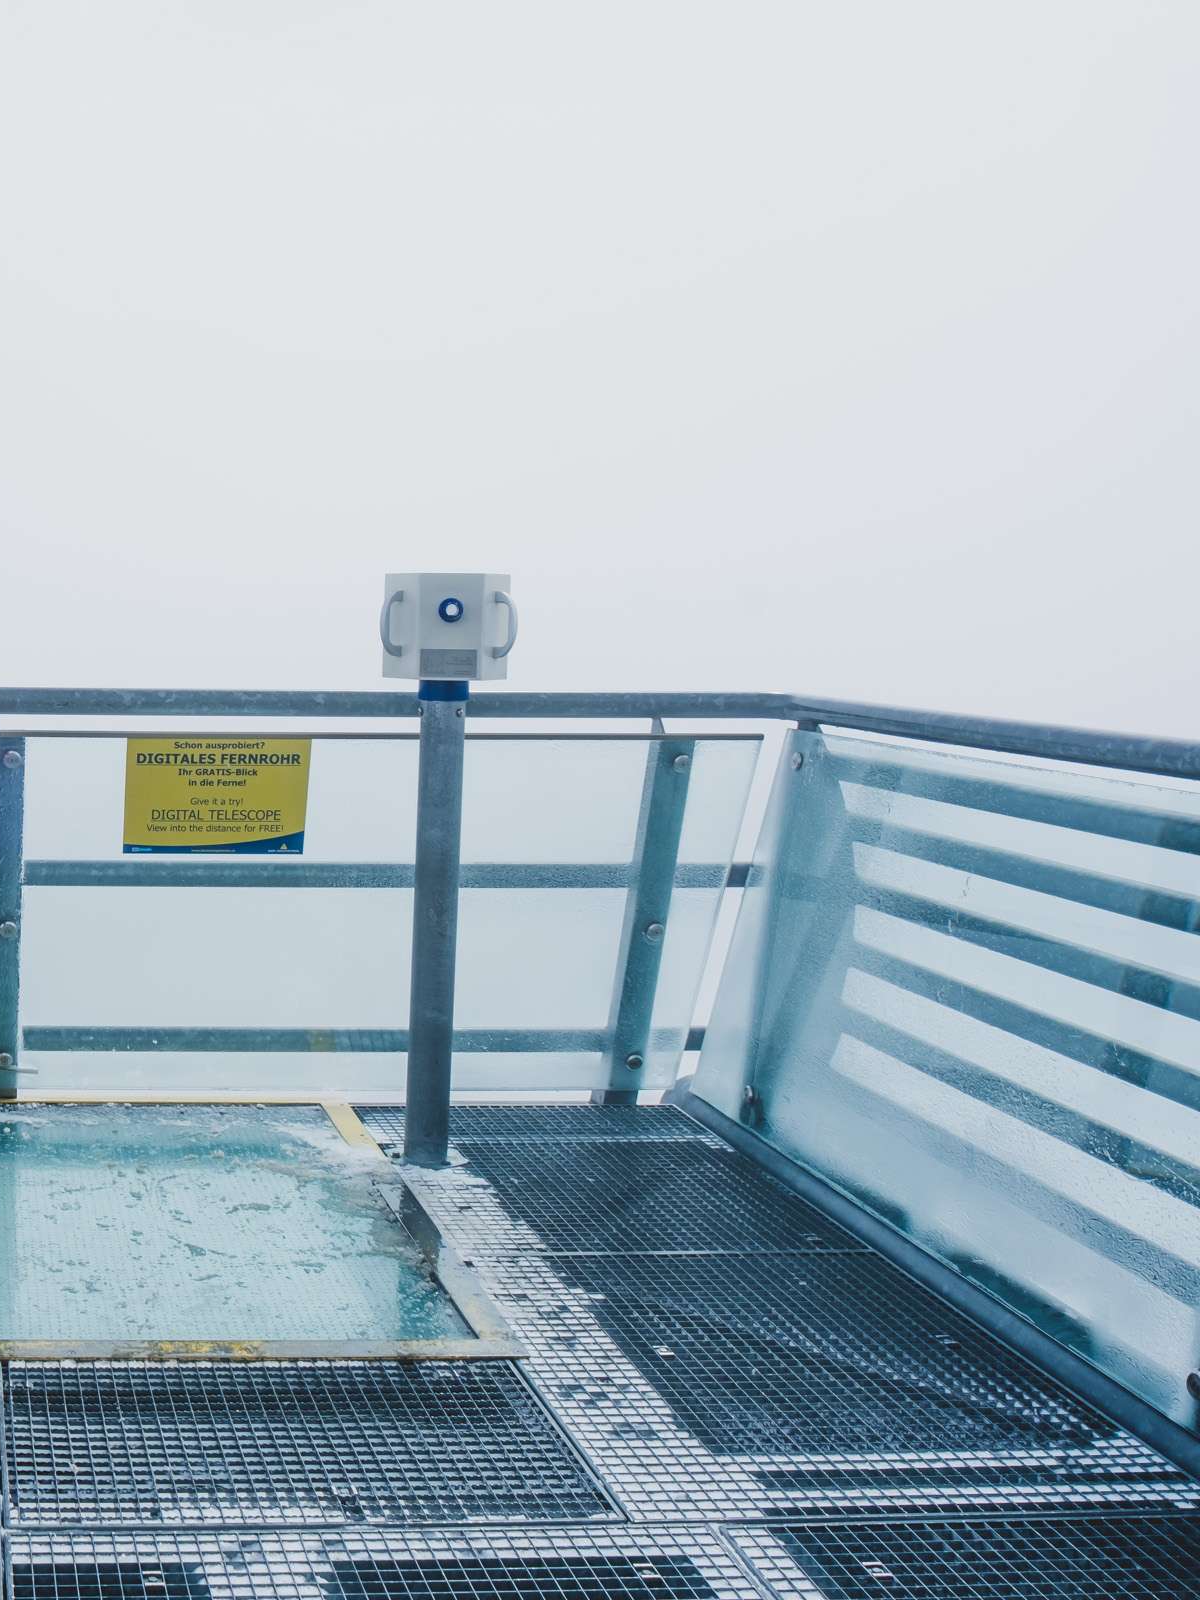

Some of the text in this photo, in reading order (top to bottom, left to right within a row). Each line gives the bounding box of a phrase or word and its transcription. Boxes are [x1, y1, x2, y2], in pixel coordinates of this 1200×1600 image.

[174, 741, 265, 751] Schon ausprobiert?
[136, 753, 301, 765] DIGITALES FERNROHR
[178, 768, 258, 776] Ihr GRATIS-Blick
[188, 779, 247, 787] in die Ferne!
[190, 797, 209, 806] Give
[212, 797, 219, 806] it
[228, 798, 244, 807] try!
[151, 809, 281, 821] DIGITAL TELESCOPE
[146, 824, 284, 833] View into the distance for FREE!
